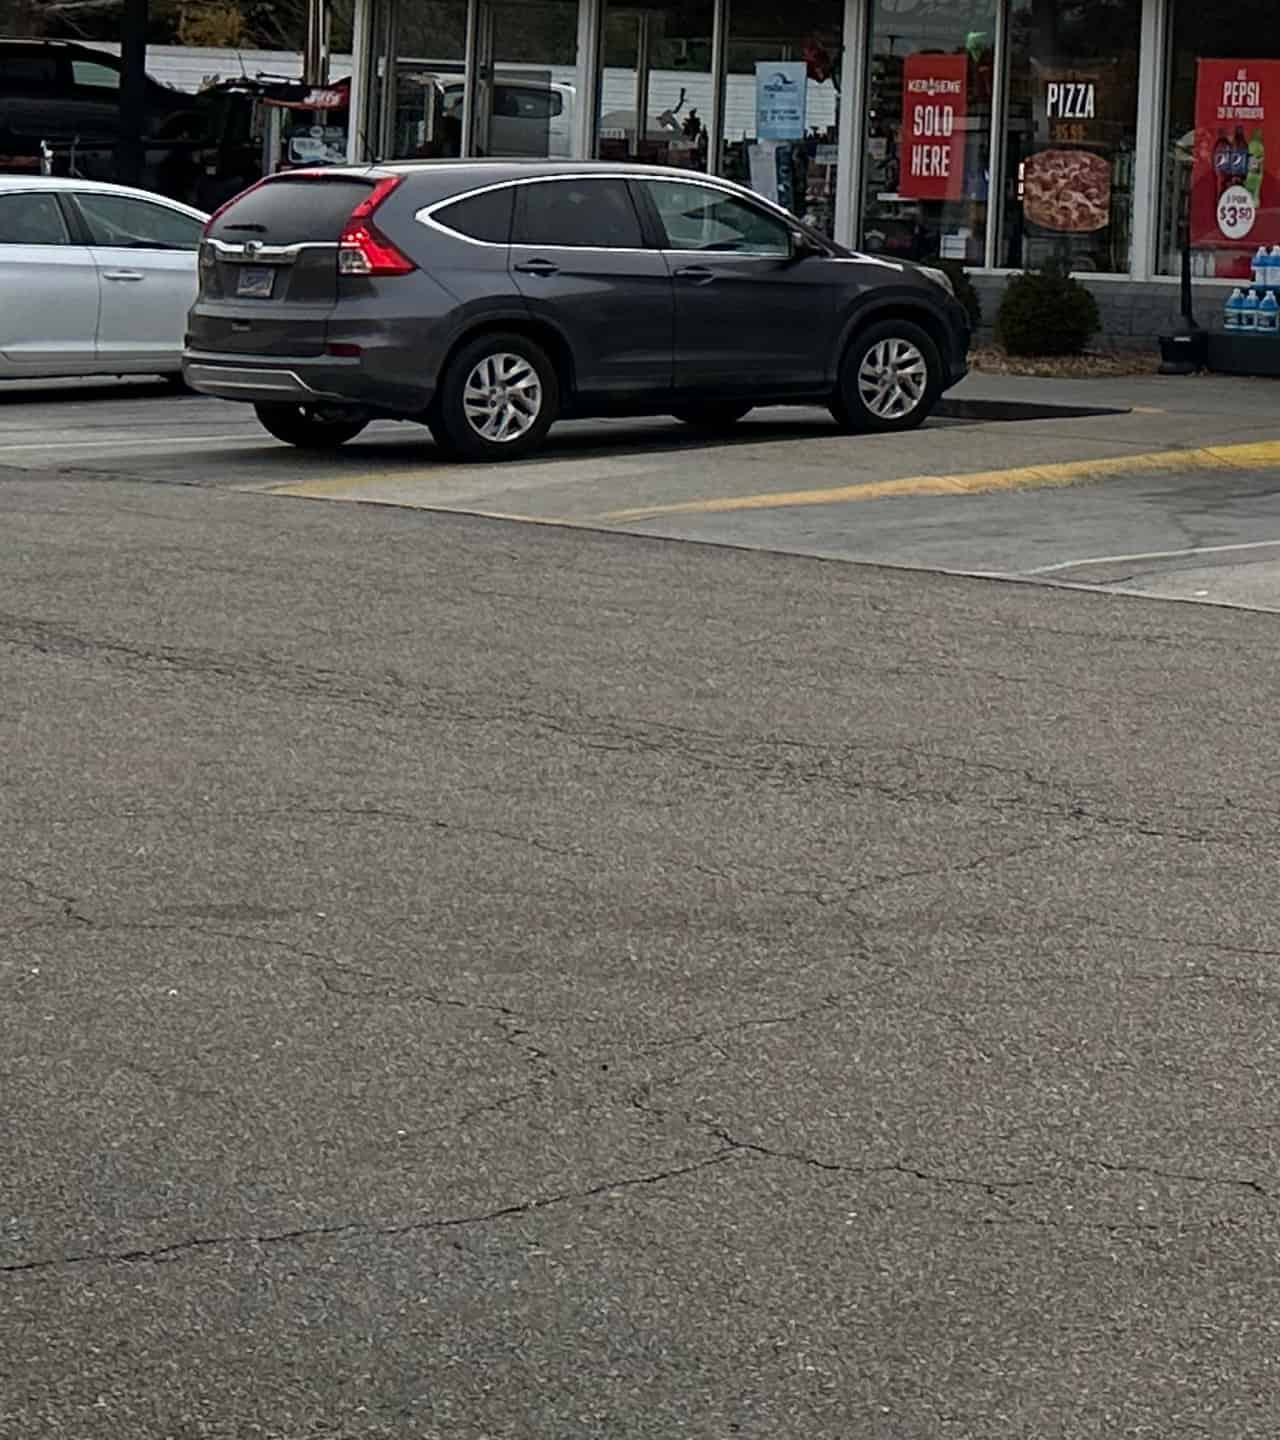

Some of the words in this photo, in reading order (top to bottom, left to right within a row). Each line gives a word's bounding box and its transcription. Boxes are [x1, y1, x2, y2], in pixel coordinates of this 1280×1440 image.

[1046, 83, 1096, 119] PIZZA
[1223, 81, 1260, 106] PEPSI
[913, 104, 953, 138] SOLD
[910, 144, 951, 177] HERE
